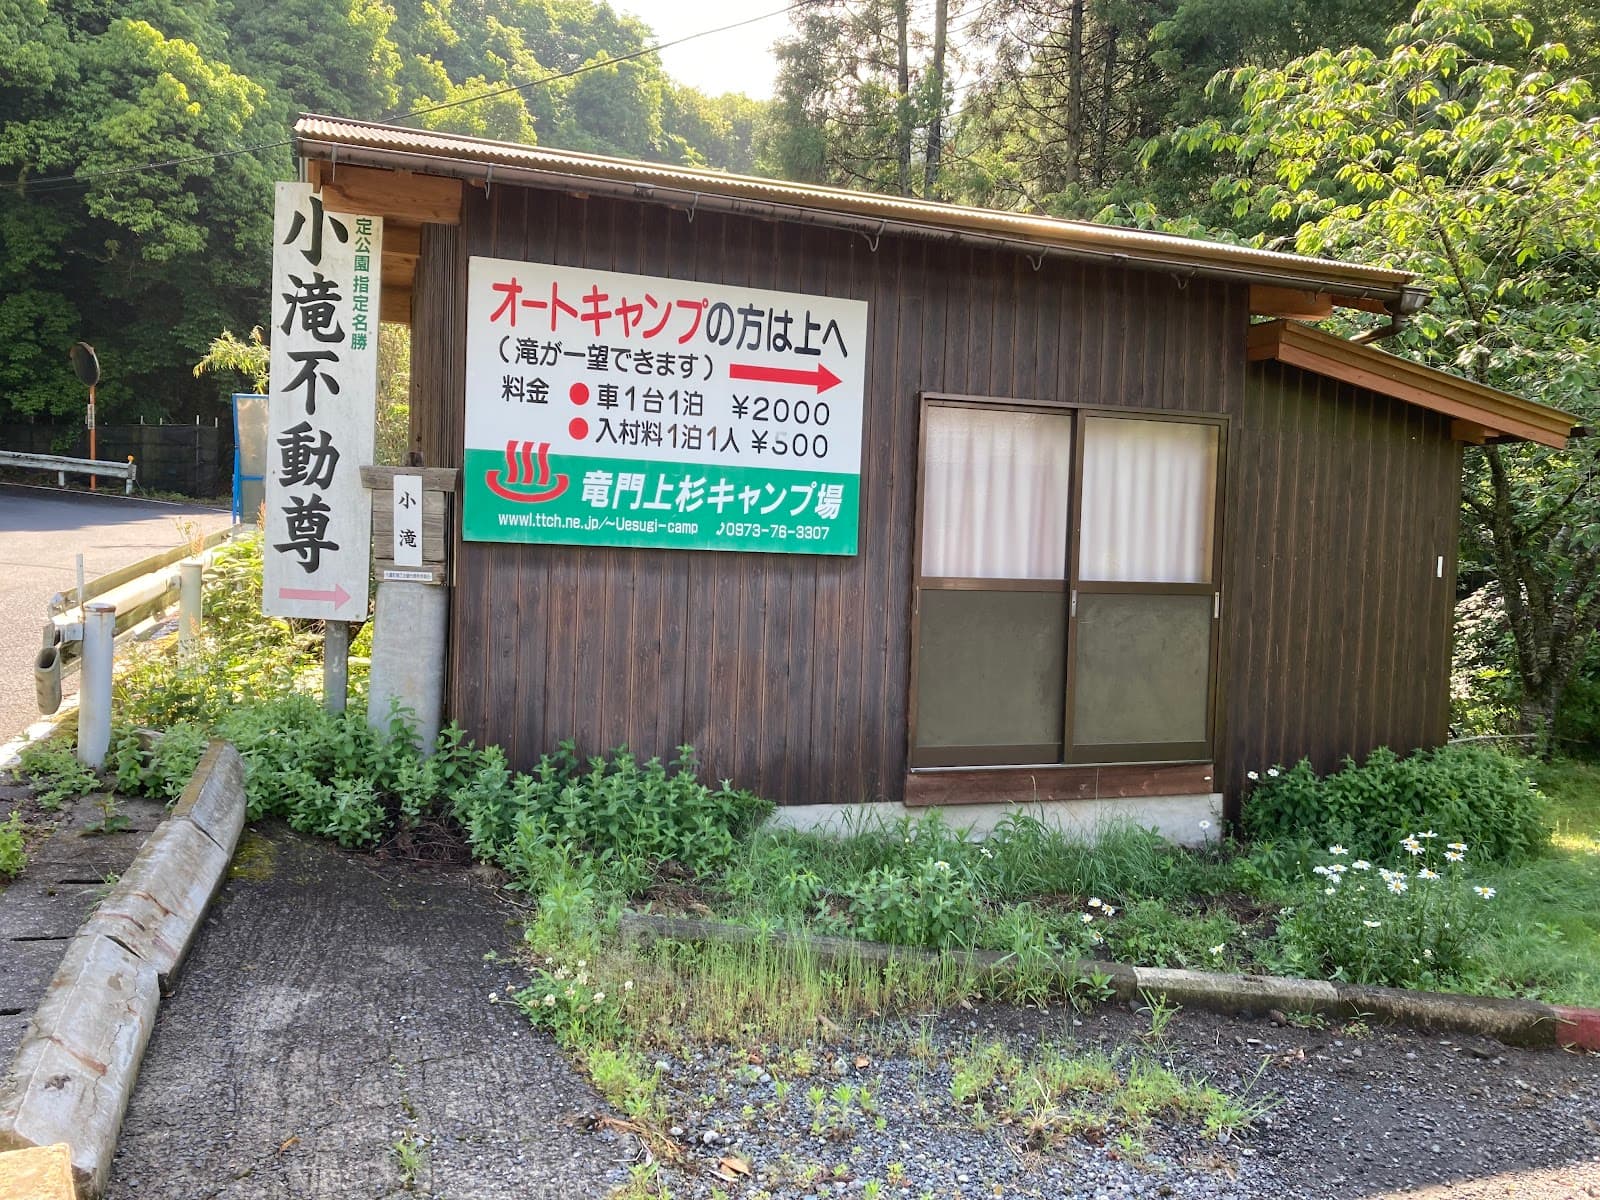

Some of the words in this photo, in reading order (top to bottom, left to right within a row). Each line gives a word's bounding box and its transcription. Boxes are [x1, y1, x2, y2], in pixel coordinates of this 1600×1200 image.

[490, 277, 848, 358] オートキャンプの方は上へ
[273, 196, 349, 574] 小滝不動尊
[502, 374, 550, 404] 料金
[595, 418, 740, 454] 入村料1泊1人
[398, 491, 417, 548] 小滝
[581, 469, 844, 520] 竜門上杉キャンプ場
[725, 523, 830, 541] 0973-76-3307
